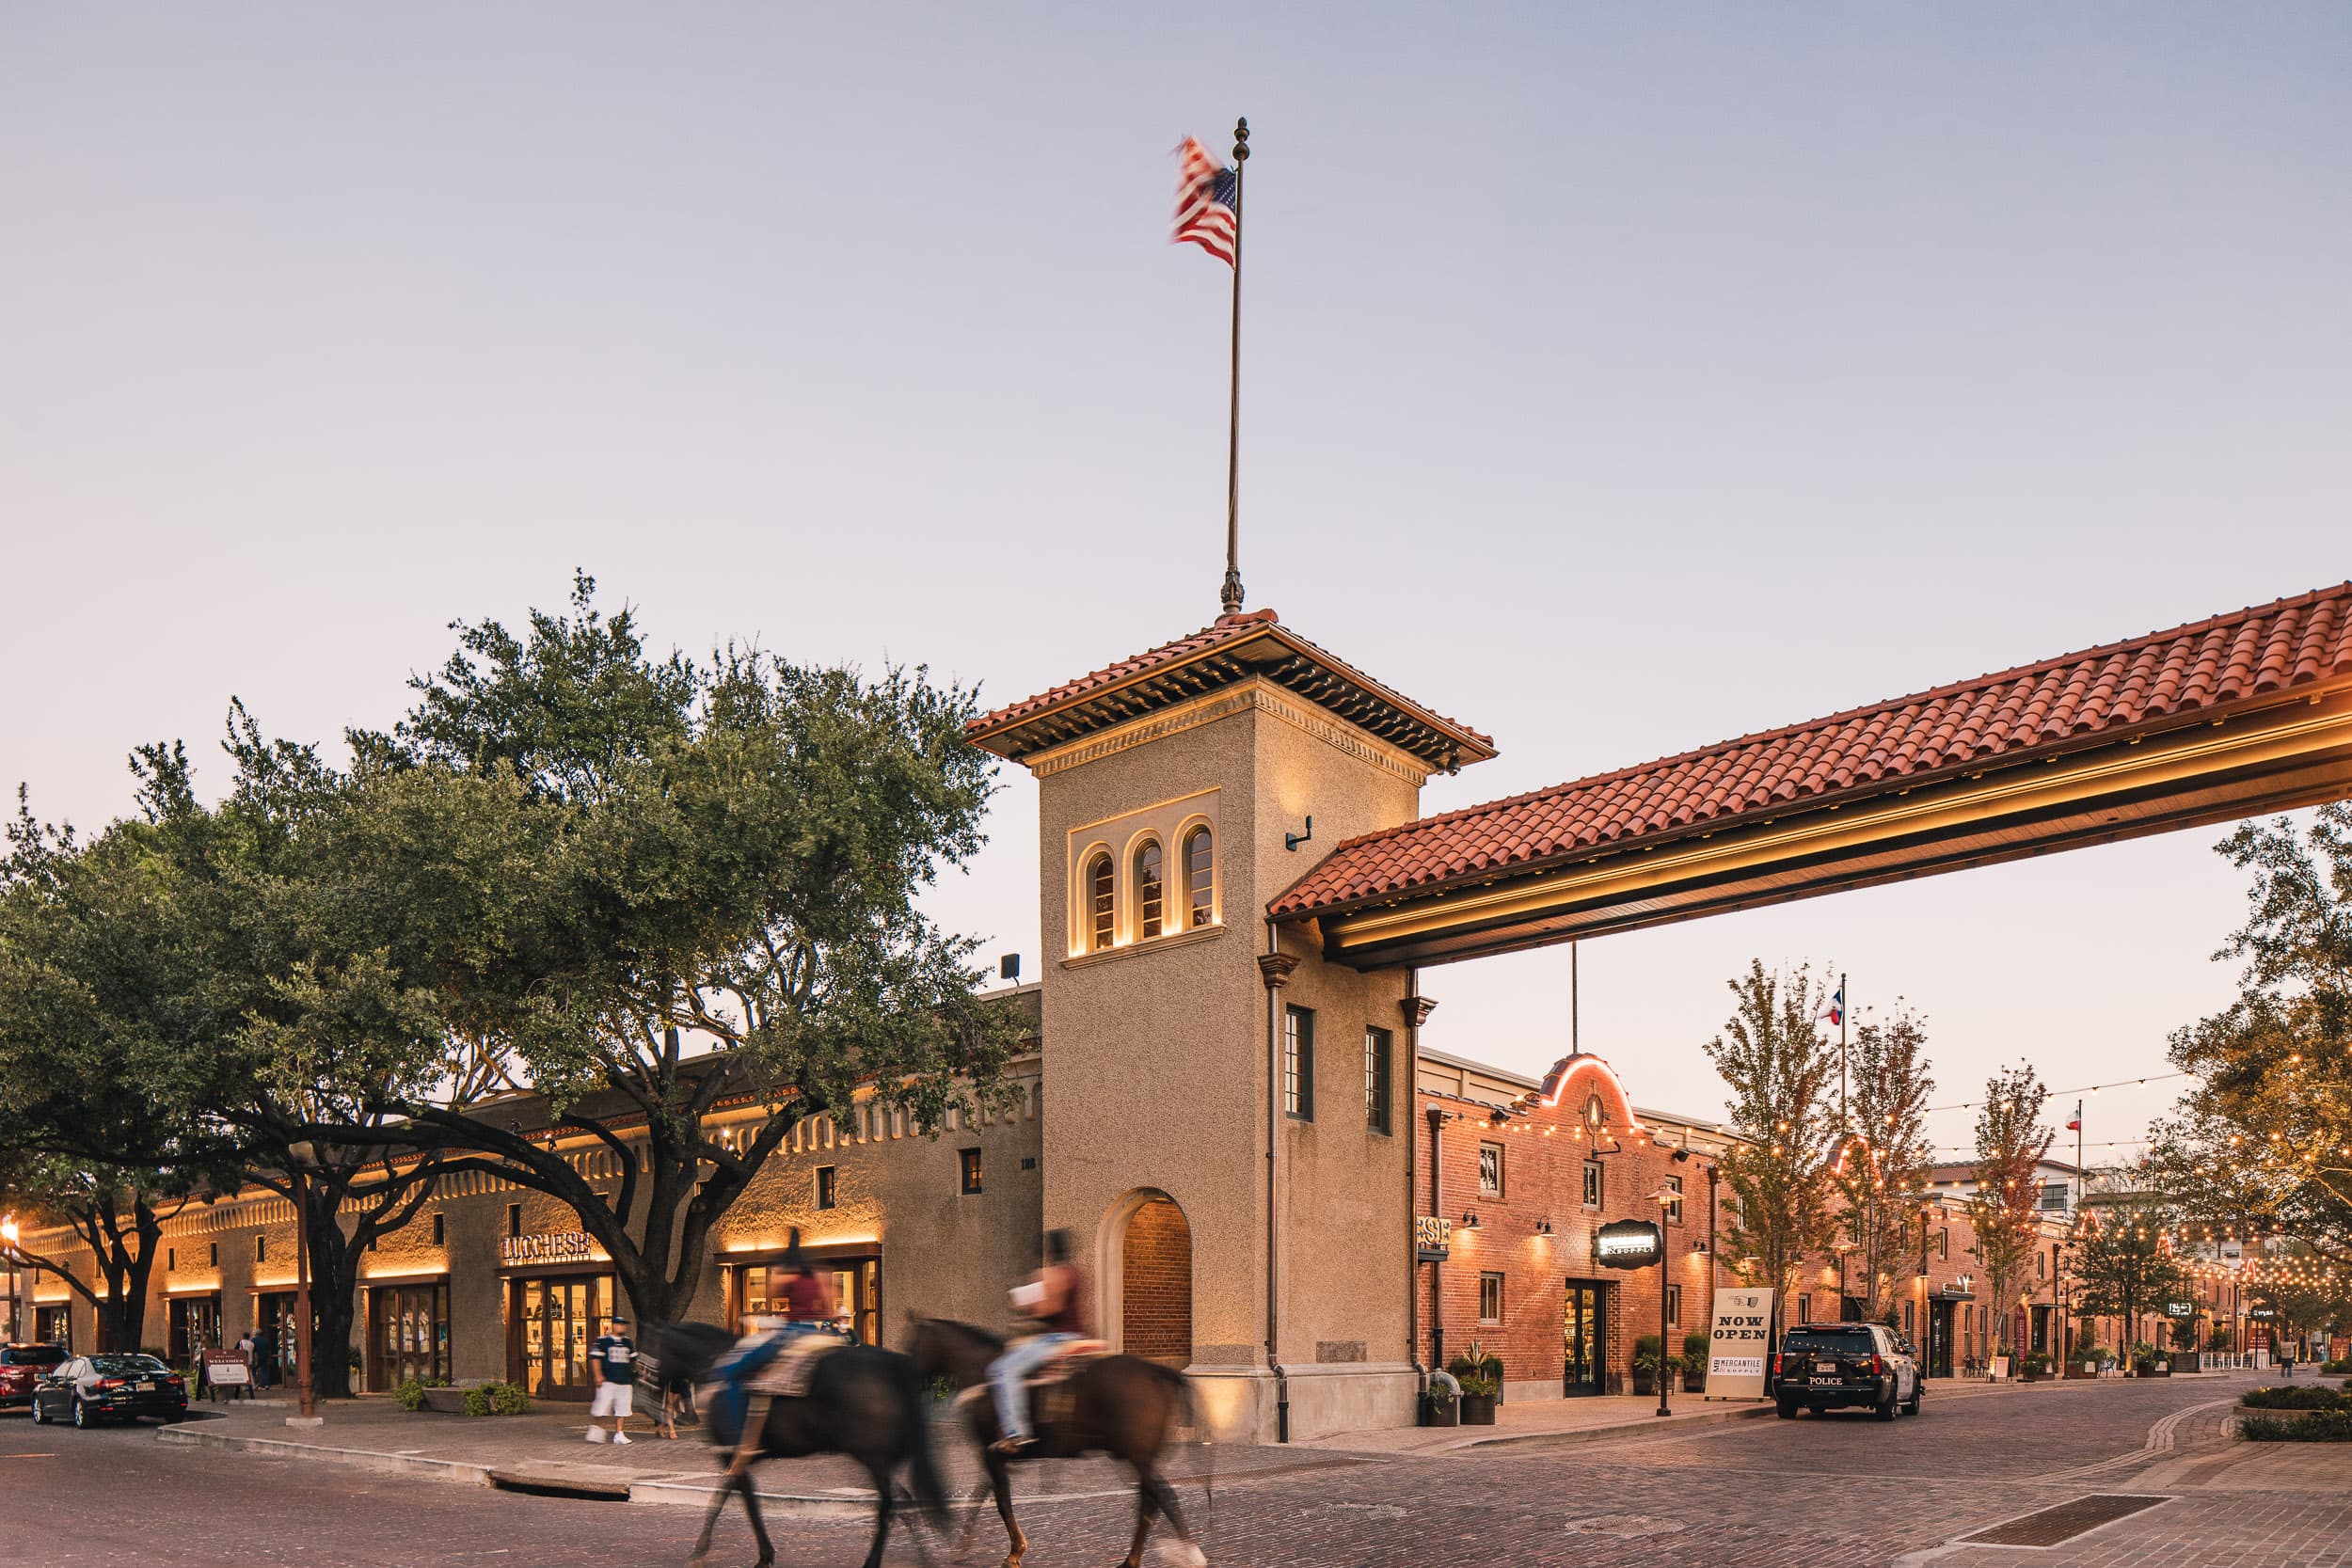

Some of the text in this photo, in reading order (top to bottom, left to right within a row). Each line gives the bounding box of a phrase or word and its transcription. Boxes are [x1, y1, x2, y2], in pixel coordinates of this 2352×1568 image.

[503, 1231, 591, 1261] LUCCHESE
[1718, 1316, 1764, 1326] NOW
[1713, 1329, 1767, 1339] OPEN
[1721, 1359, 1761, 1368] MERCANTILE
[1809, 1377, 1843, 1386] POLICE
